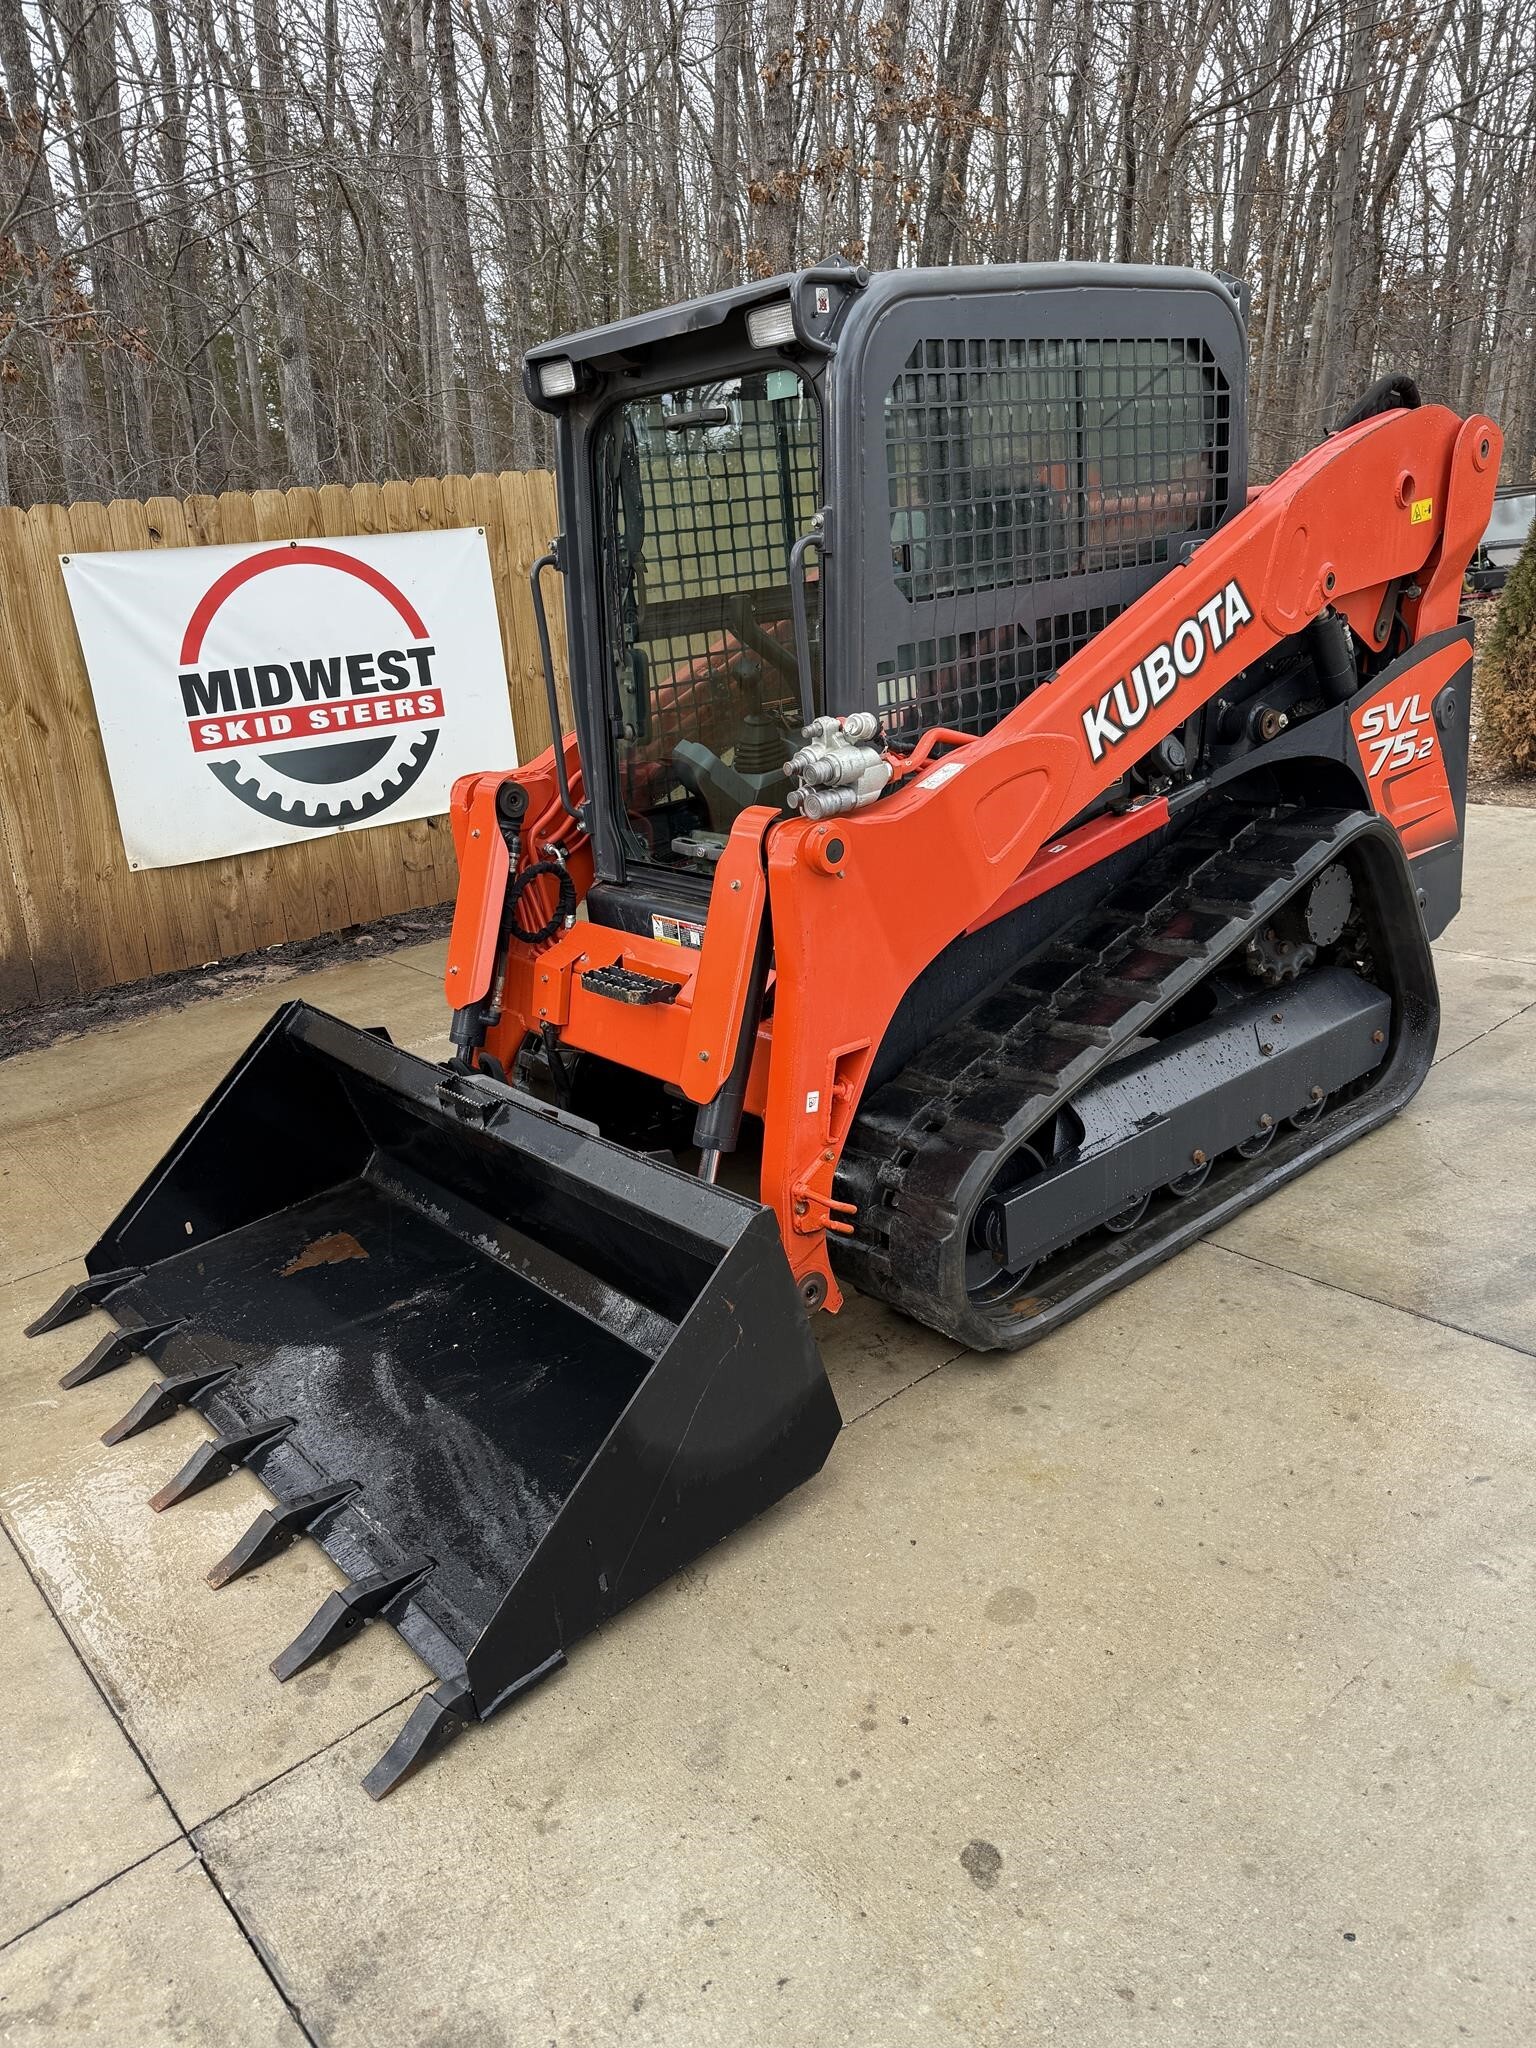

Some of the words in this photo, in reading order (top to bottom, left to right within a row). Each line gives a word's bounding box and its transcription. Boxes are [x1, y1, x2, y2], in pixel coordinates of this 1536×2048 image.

[178, 646, 436, 717] MIDWEST
[1081, 579, 1254, 762] KUBOTA
[200, 714, 293, 745] SKID
[309, 695, 438, 730] STEERS
[1358, 694, 1430, 742] SVL
